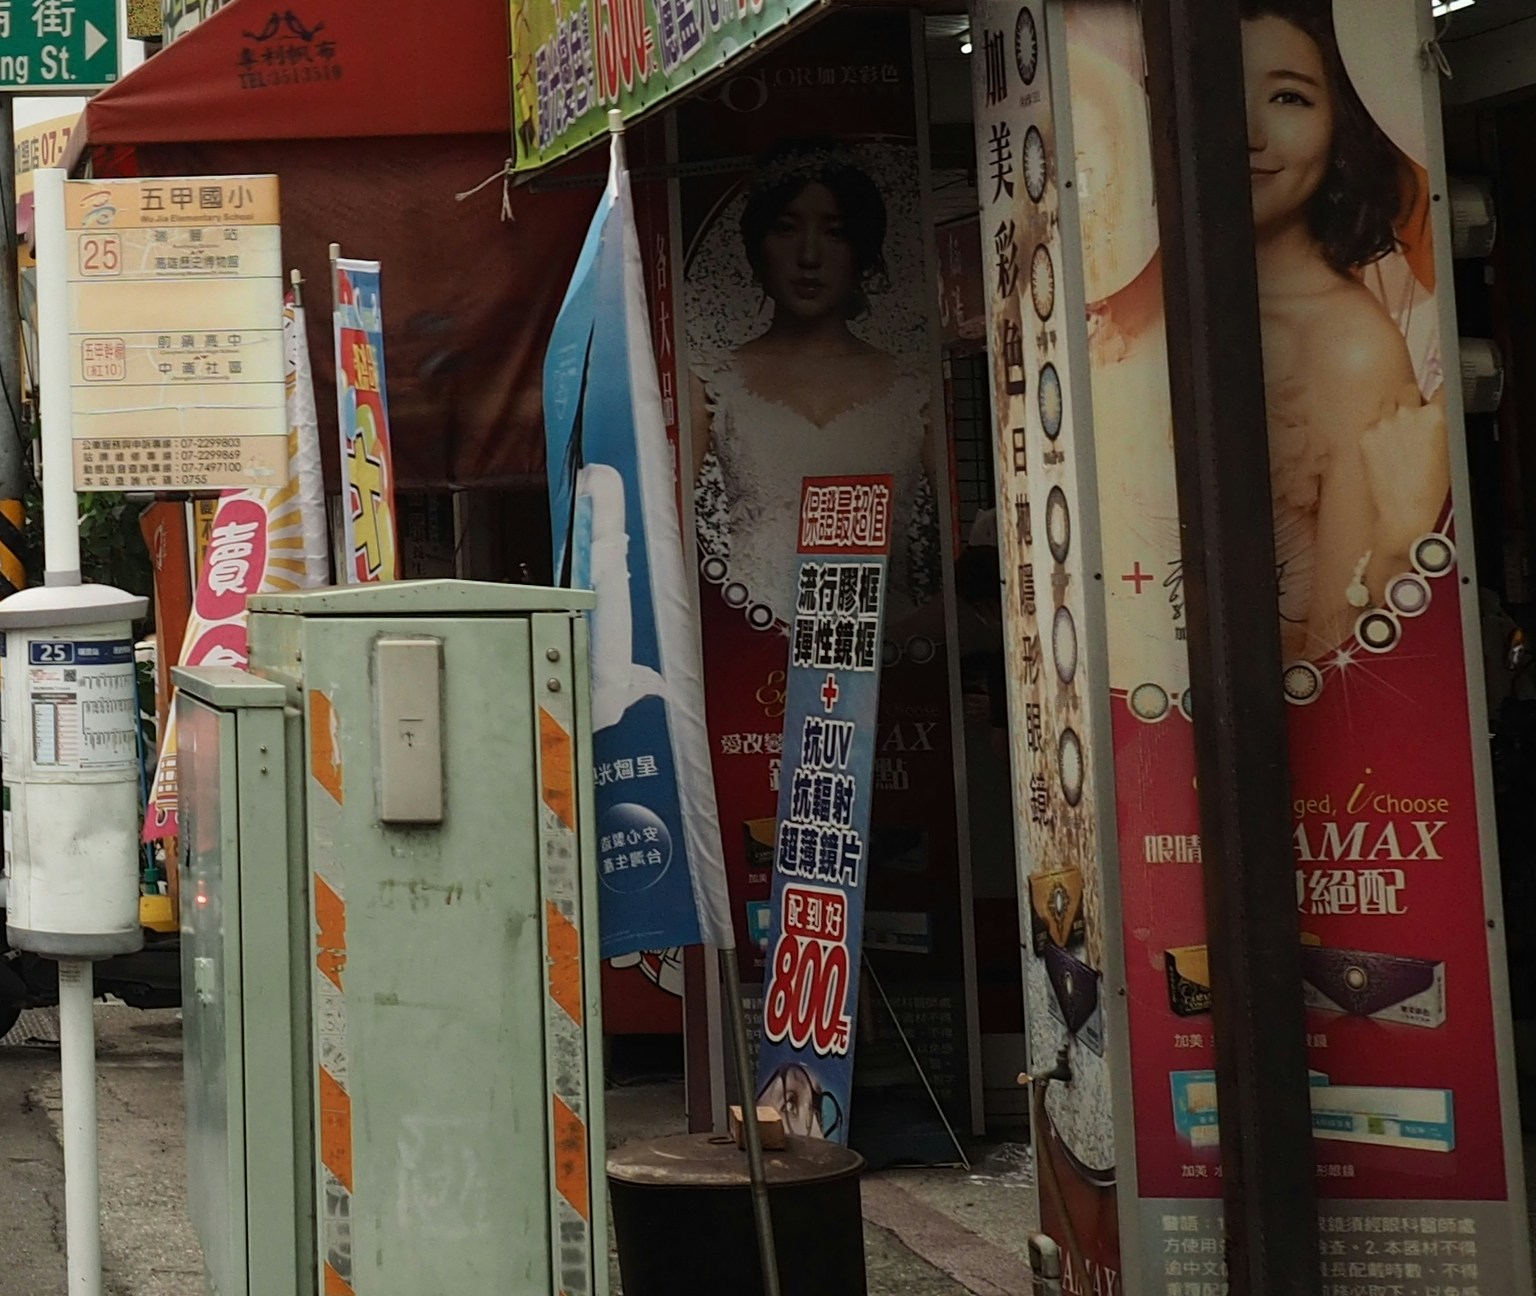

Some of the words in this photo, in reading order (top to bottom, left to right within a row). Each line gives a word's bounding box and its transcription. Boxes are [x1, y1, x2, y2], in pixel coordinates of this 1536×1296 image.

[39, 45, 77, 81] St.
[140, 186, 254, 212] 五甲國小
[982, 27, 1026, 399] 加美彩色
[82, 239, 119, 271] 25
[801, 485, 889, 547] 保證最超值
[796, 562, 883, 617] 流行膠框
[39, 644, 66, 662] 25
[792, 615, 879, 672] 彈性鏡框
[801, 715, 855, 771] 抗UV
[790, 768, 856, 830] 抗輻射
[1373, 794, 1450, 815] Choose
[776, 818, 863, 888] 超薄鏡片
[787, 893, 843, 937] 配到好
[764, 932, 850, 1054] 800
